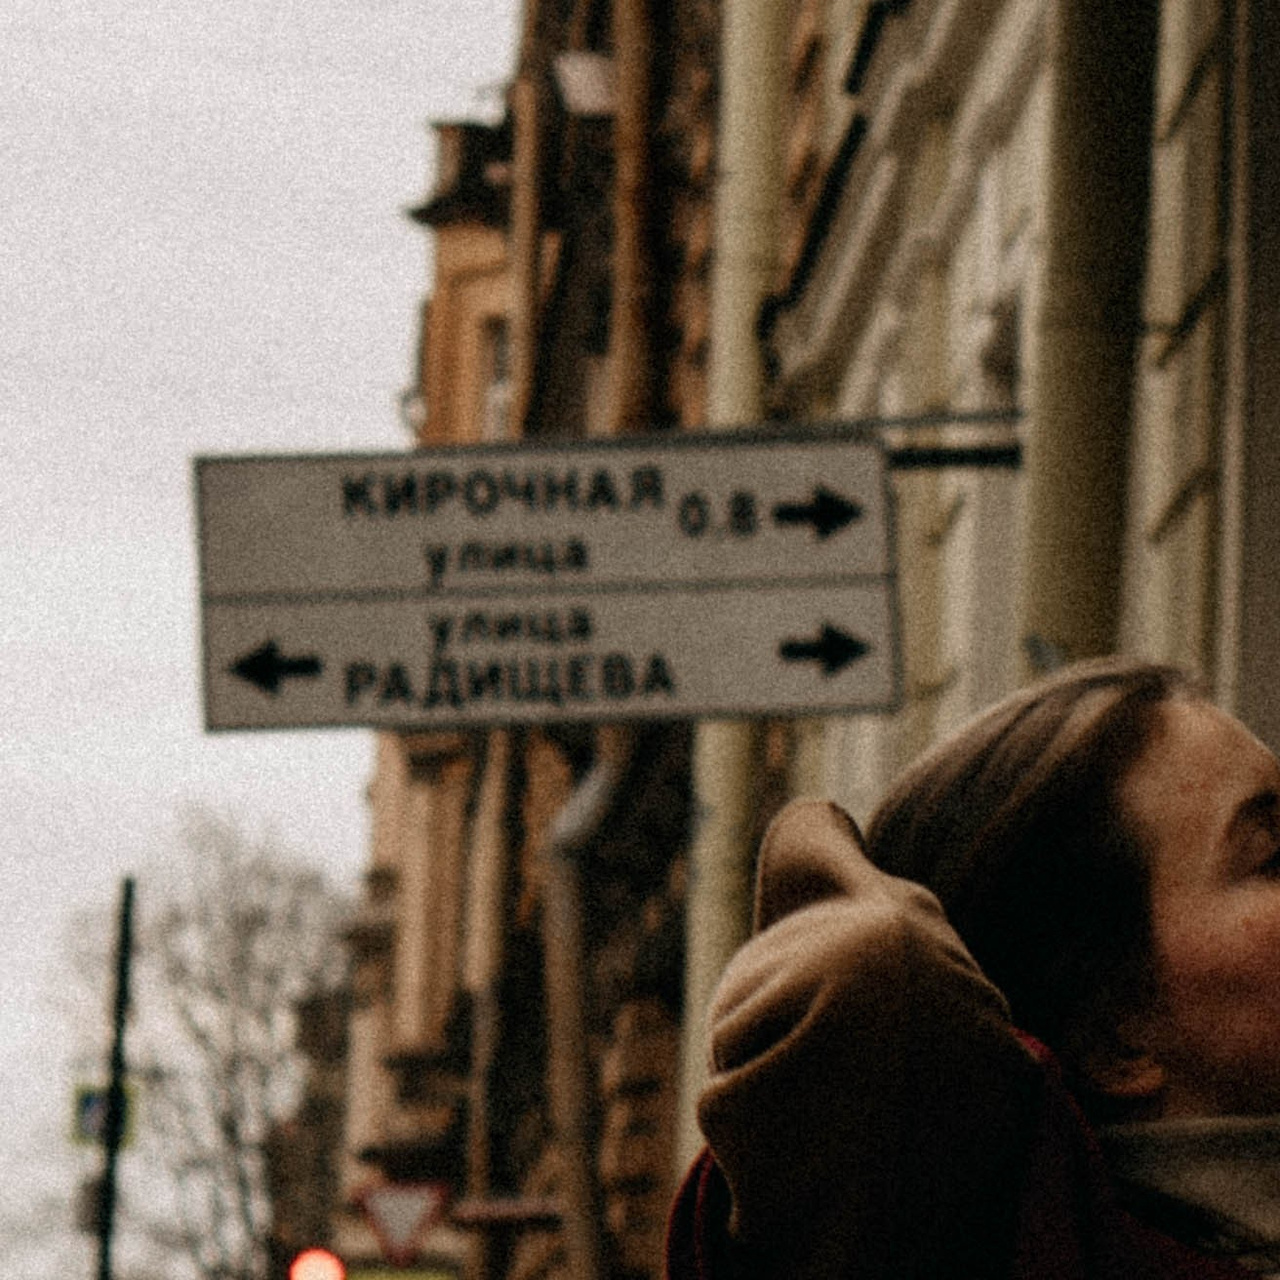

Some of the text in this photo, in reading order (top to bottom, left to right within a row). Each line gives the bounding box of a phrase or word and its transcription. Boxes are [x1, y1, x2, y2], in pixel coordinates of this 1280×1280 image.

[342, 465, 664, 517] КИРОЧНАЯ
[426, 537, 590, 588] улица
[428, 606, 593, 653] улица
[343, 653, 676, 708] РАДИЩЕВА
